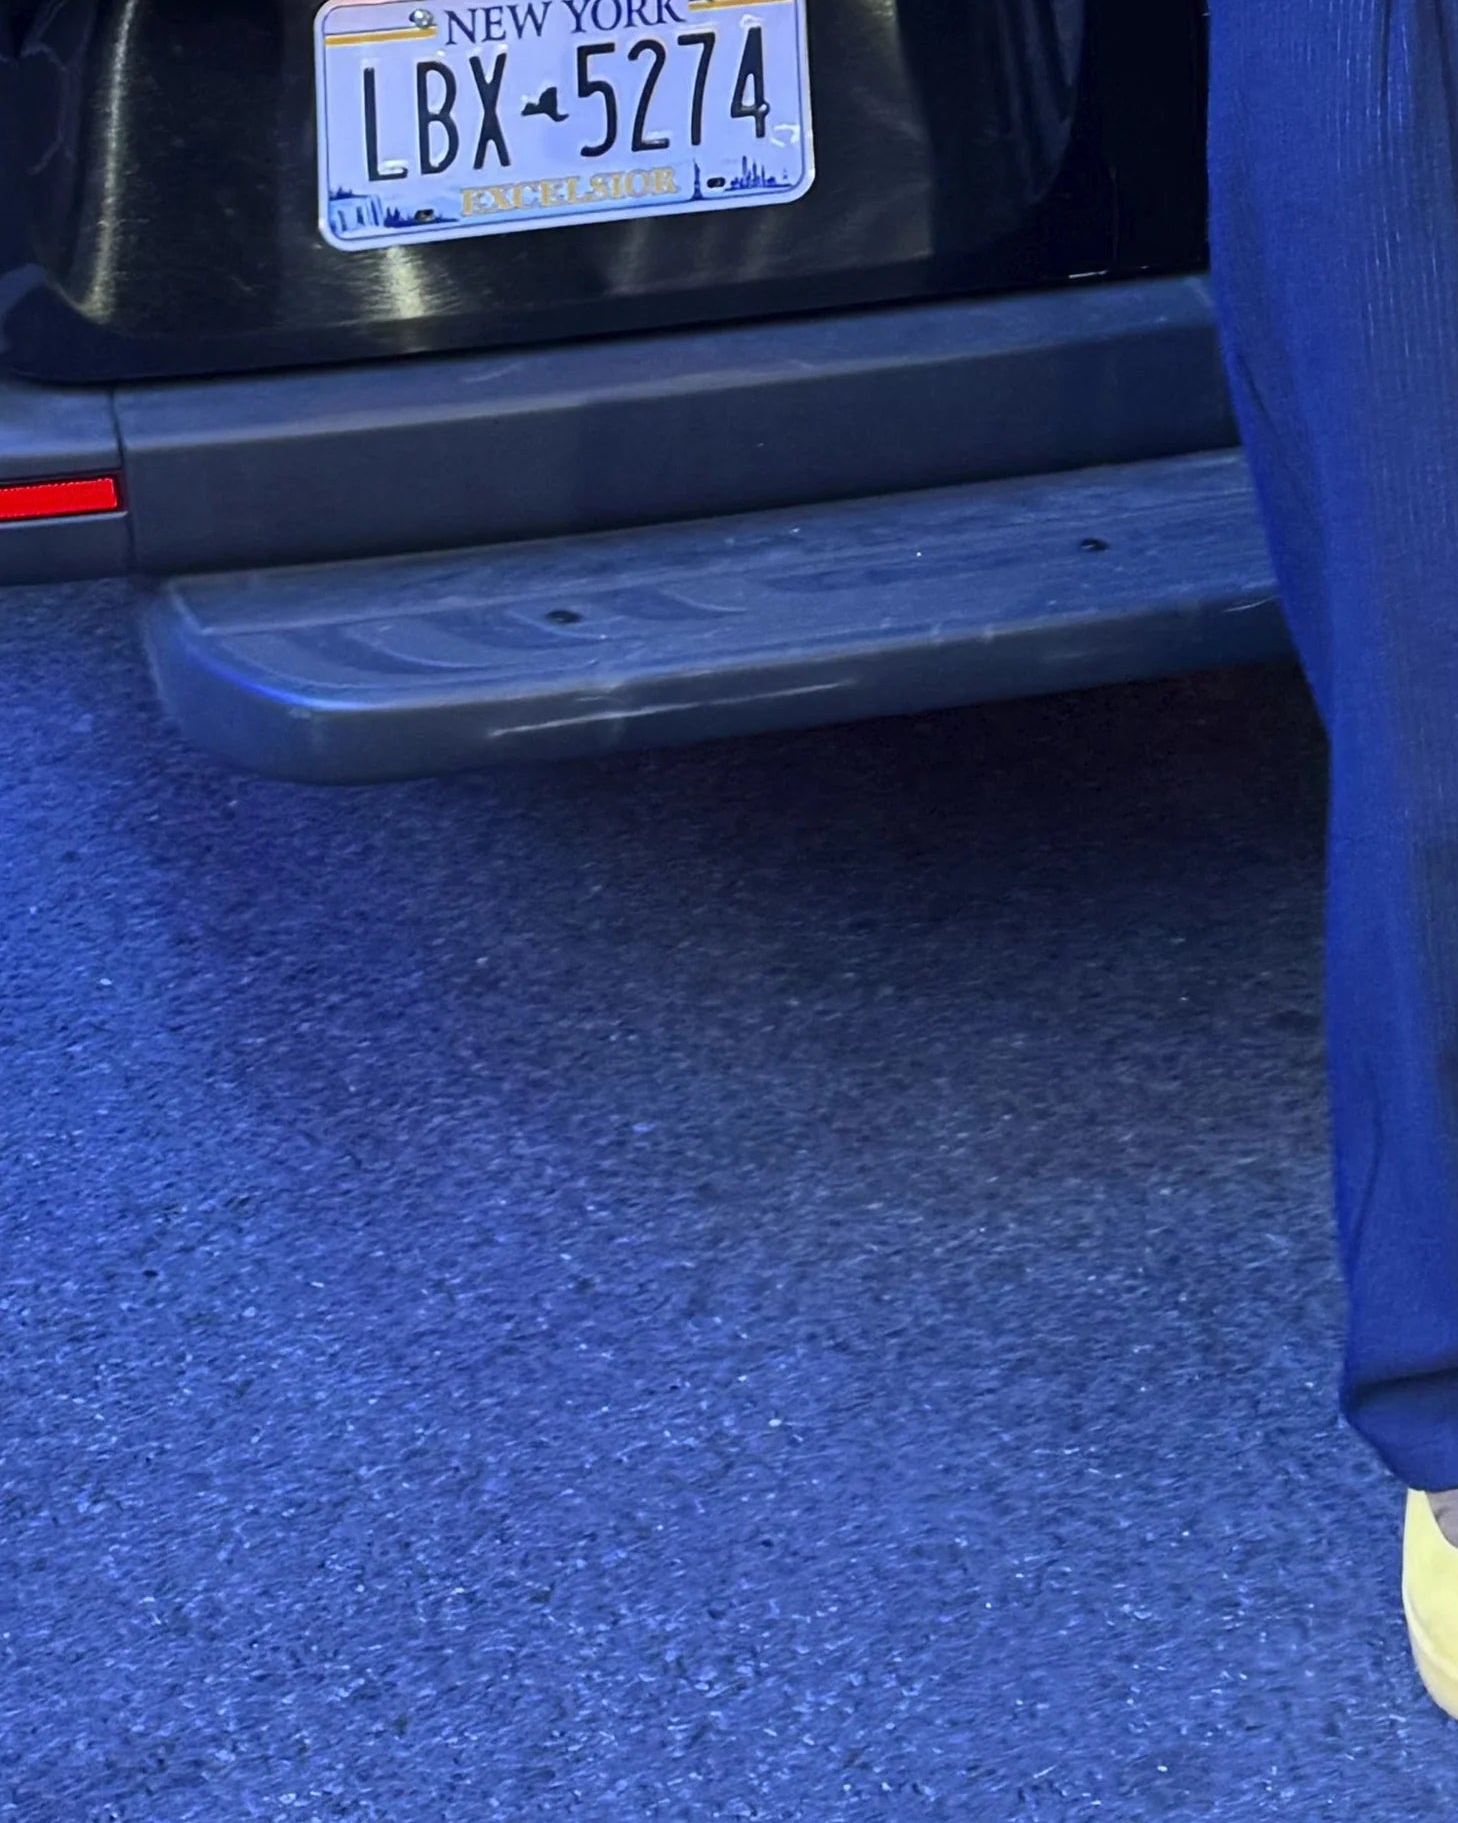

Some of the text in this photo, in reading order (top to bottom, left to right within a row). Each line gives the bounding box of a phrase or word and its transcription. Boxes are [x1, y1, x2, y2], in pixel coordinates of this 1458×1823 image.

[445, 0, 553, 46] NEW
[363, 26, 770, 182] LBX 5274
[459, 166, 682, 218] EXCELSIOR
